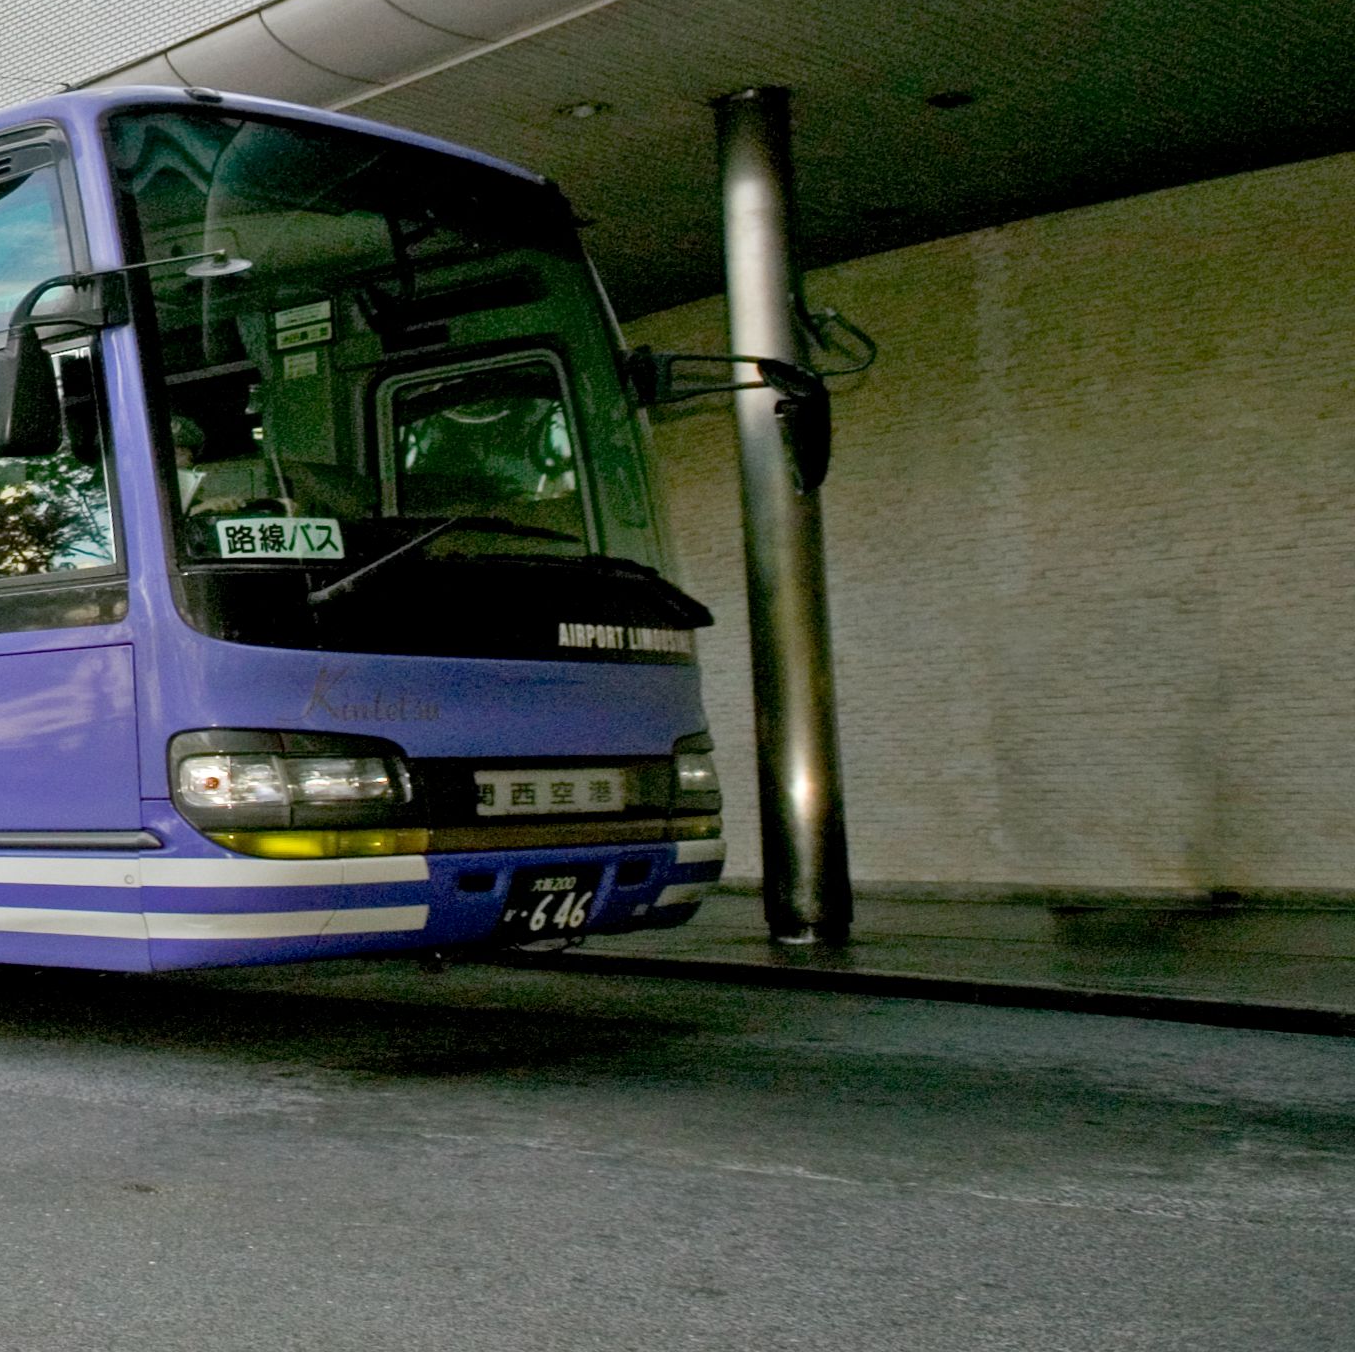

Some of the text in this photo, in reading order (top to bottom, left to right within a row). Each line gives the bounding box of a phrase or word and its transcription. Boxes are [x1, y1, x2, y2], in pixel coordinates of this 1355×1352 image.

[224, 523, 340, 555] 路線バス
[558, 622, 624, 649] AIRPORT
